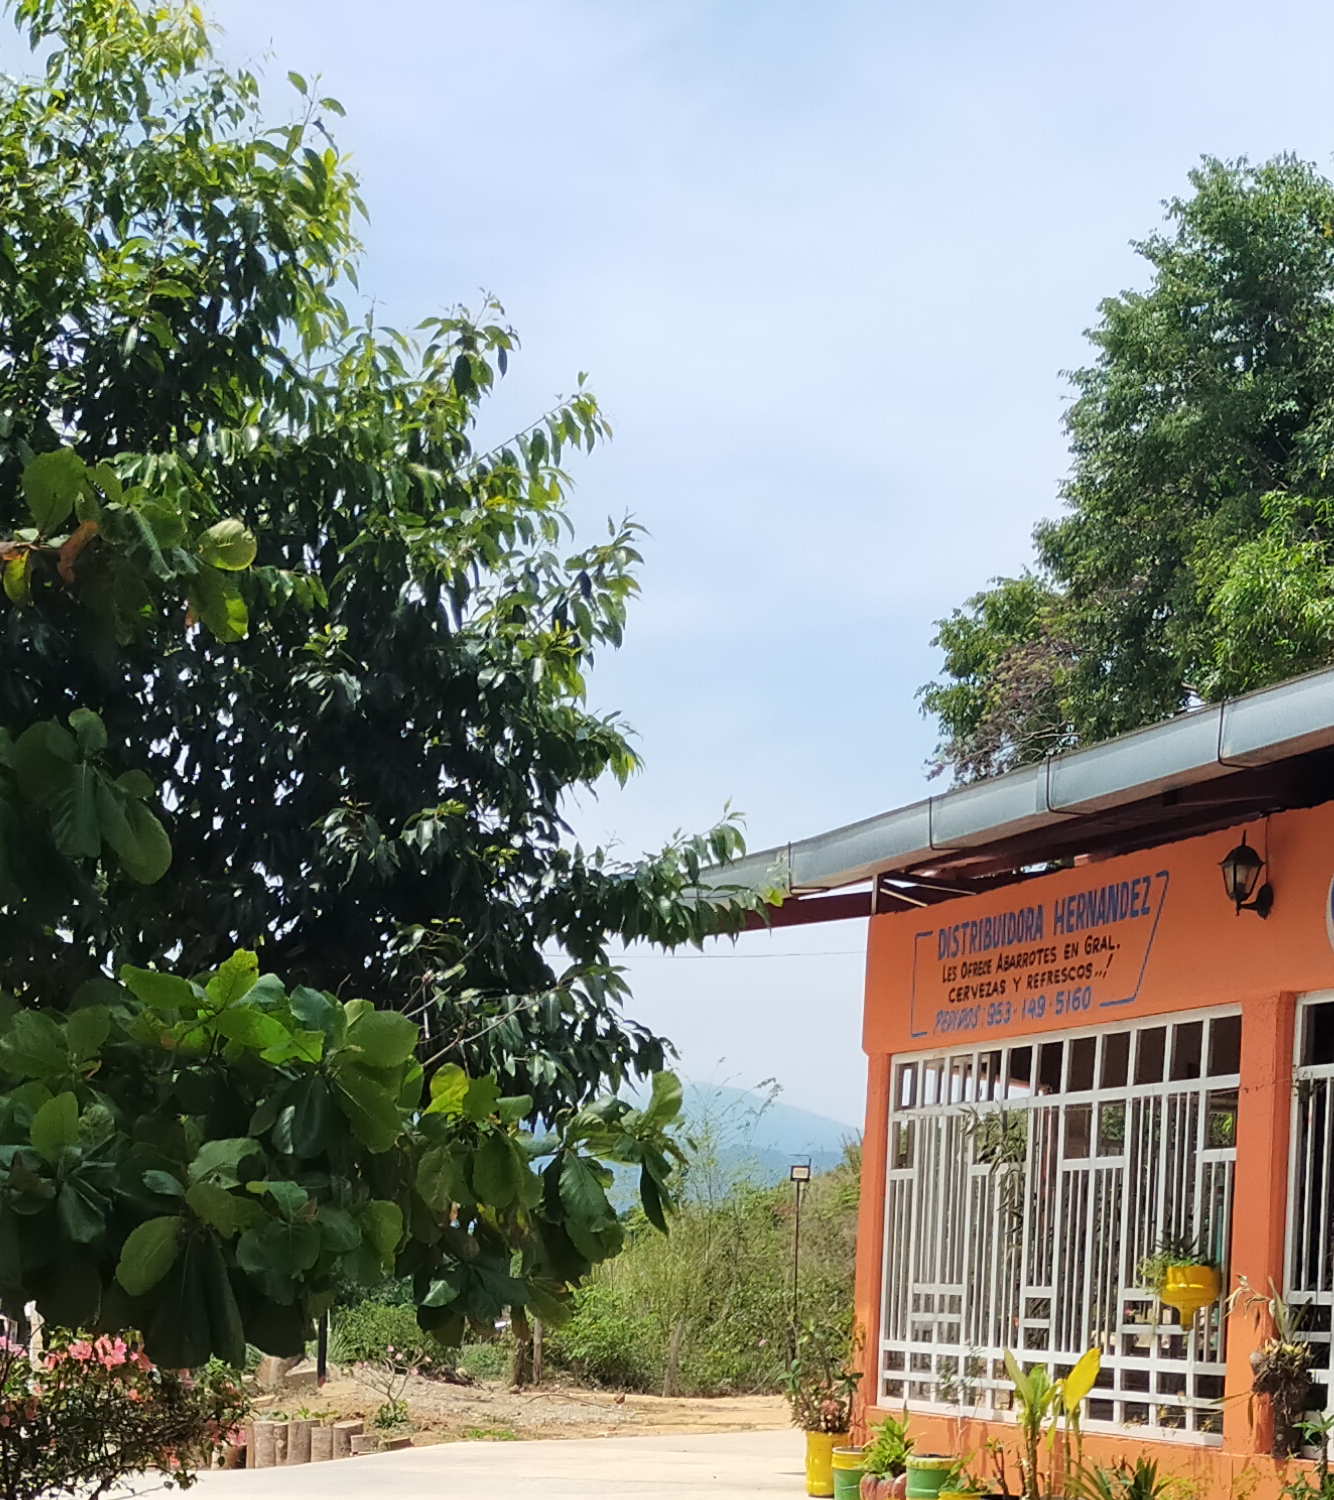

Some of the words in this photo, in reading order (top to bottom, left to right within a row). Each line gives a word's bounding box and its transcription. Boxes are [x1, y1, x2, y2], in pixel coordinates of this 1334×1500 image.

[938, 904, 1043, 960] DISTRIBUIDORA
[1053, 876, 1151, 936] HERNANDEZ
[942, 964, 957, 983] LES
[961, 959, 992, 980] OFRECE
[996, 946, 1057, 975] ABARROTES
[1064, 942, 1079, 960] EN
[1084, 934, 1121, 955] GRAL.
[948, 979, 1006, 1003] CERVEZAS
[1013, 974, 1022, 993] Y
